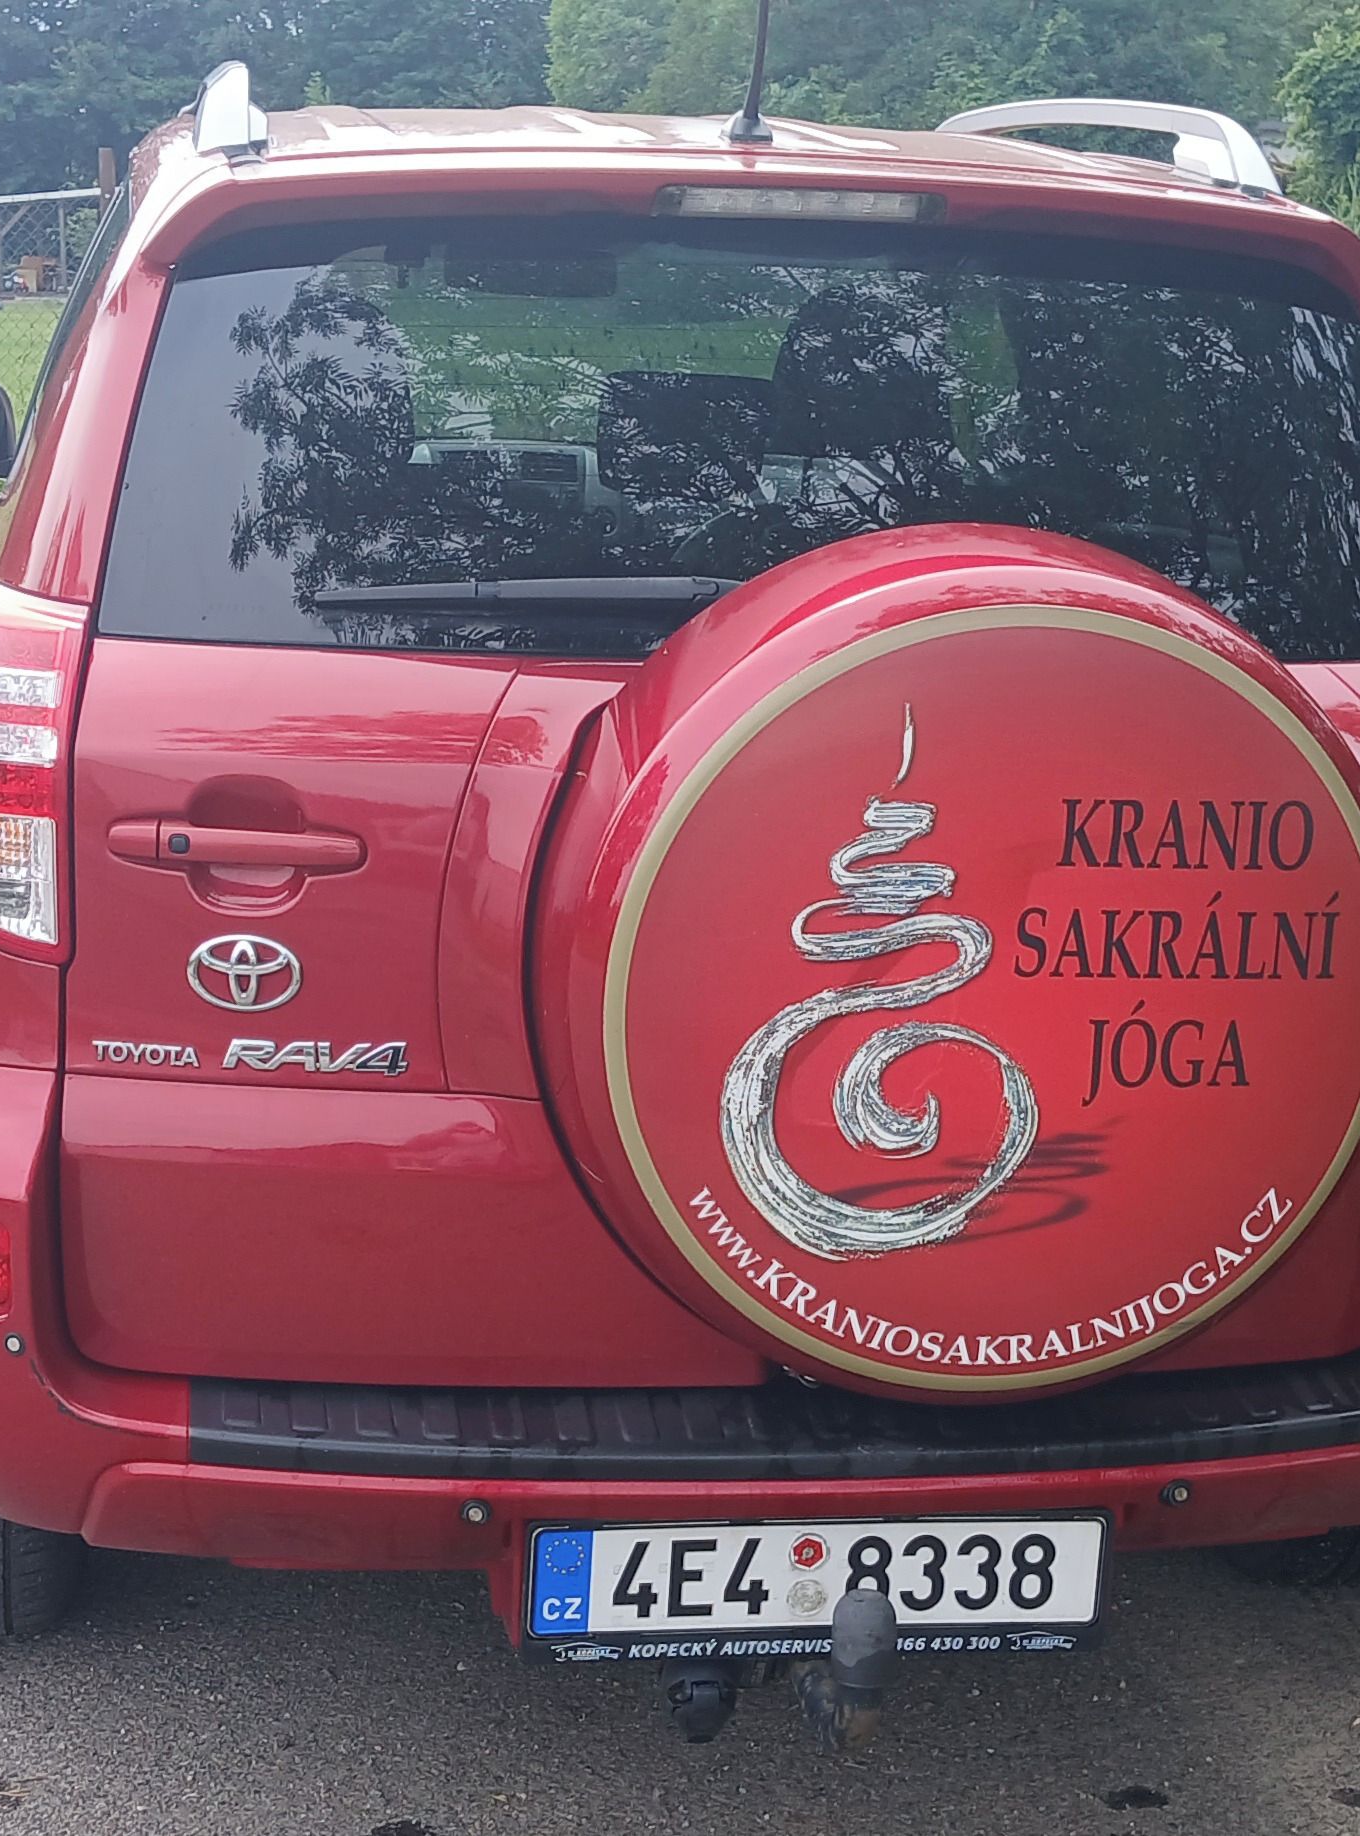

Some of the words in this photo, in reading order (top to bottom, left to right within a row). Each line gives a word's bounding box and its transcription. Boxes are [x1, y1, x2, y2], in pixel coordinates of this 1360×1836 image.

[1056, 798, 1315, 871] KRANIO
[1013, 890, 1341, 980] SAKRÁLNÍ
[92, 1040, 200, 1068] TOYOTA
[221, 1037, 409, 1077] RAV4
[1081, 999, 1250, 1107] JÓGA
[689, 1186, 1293, 1366] www.KRANIOSAKRALNIJOGA.CZ
[542, 1597, 582, 1621] CZ
[612, 1537, 769, 1619] 4E4
[845, 1534, 1056, 1612] 8338
[628, 1638, 717, 1658] KOPECKÝ
[719, 1638, 834, 1656] AUTOSERVIS
[930, 1637, 964, 1651] 430
[966, 1636, 1001, 1650] 300
